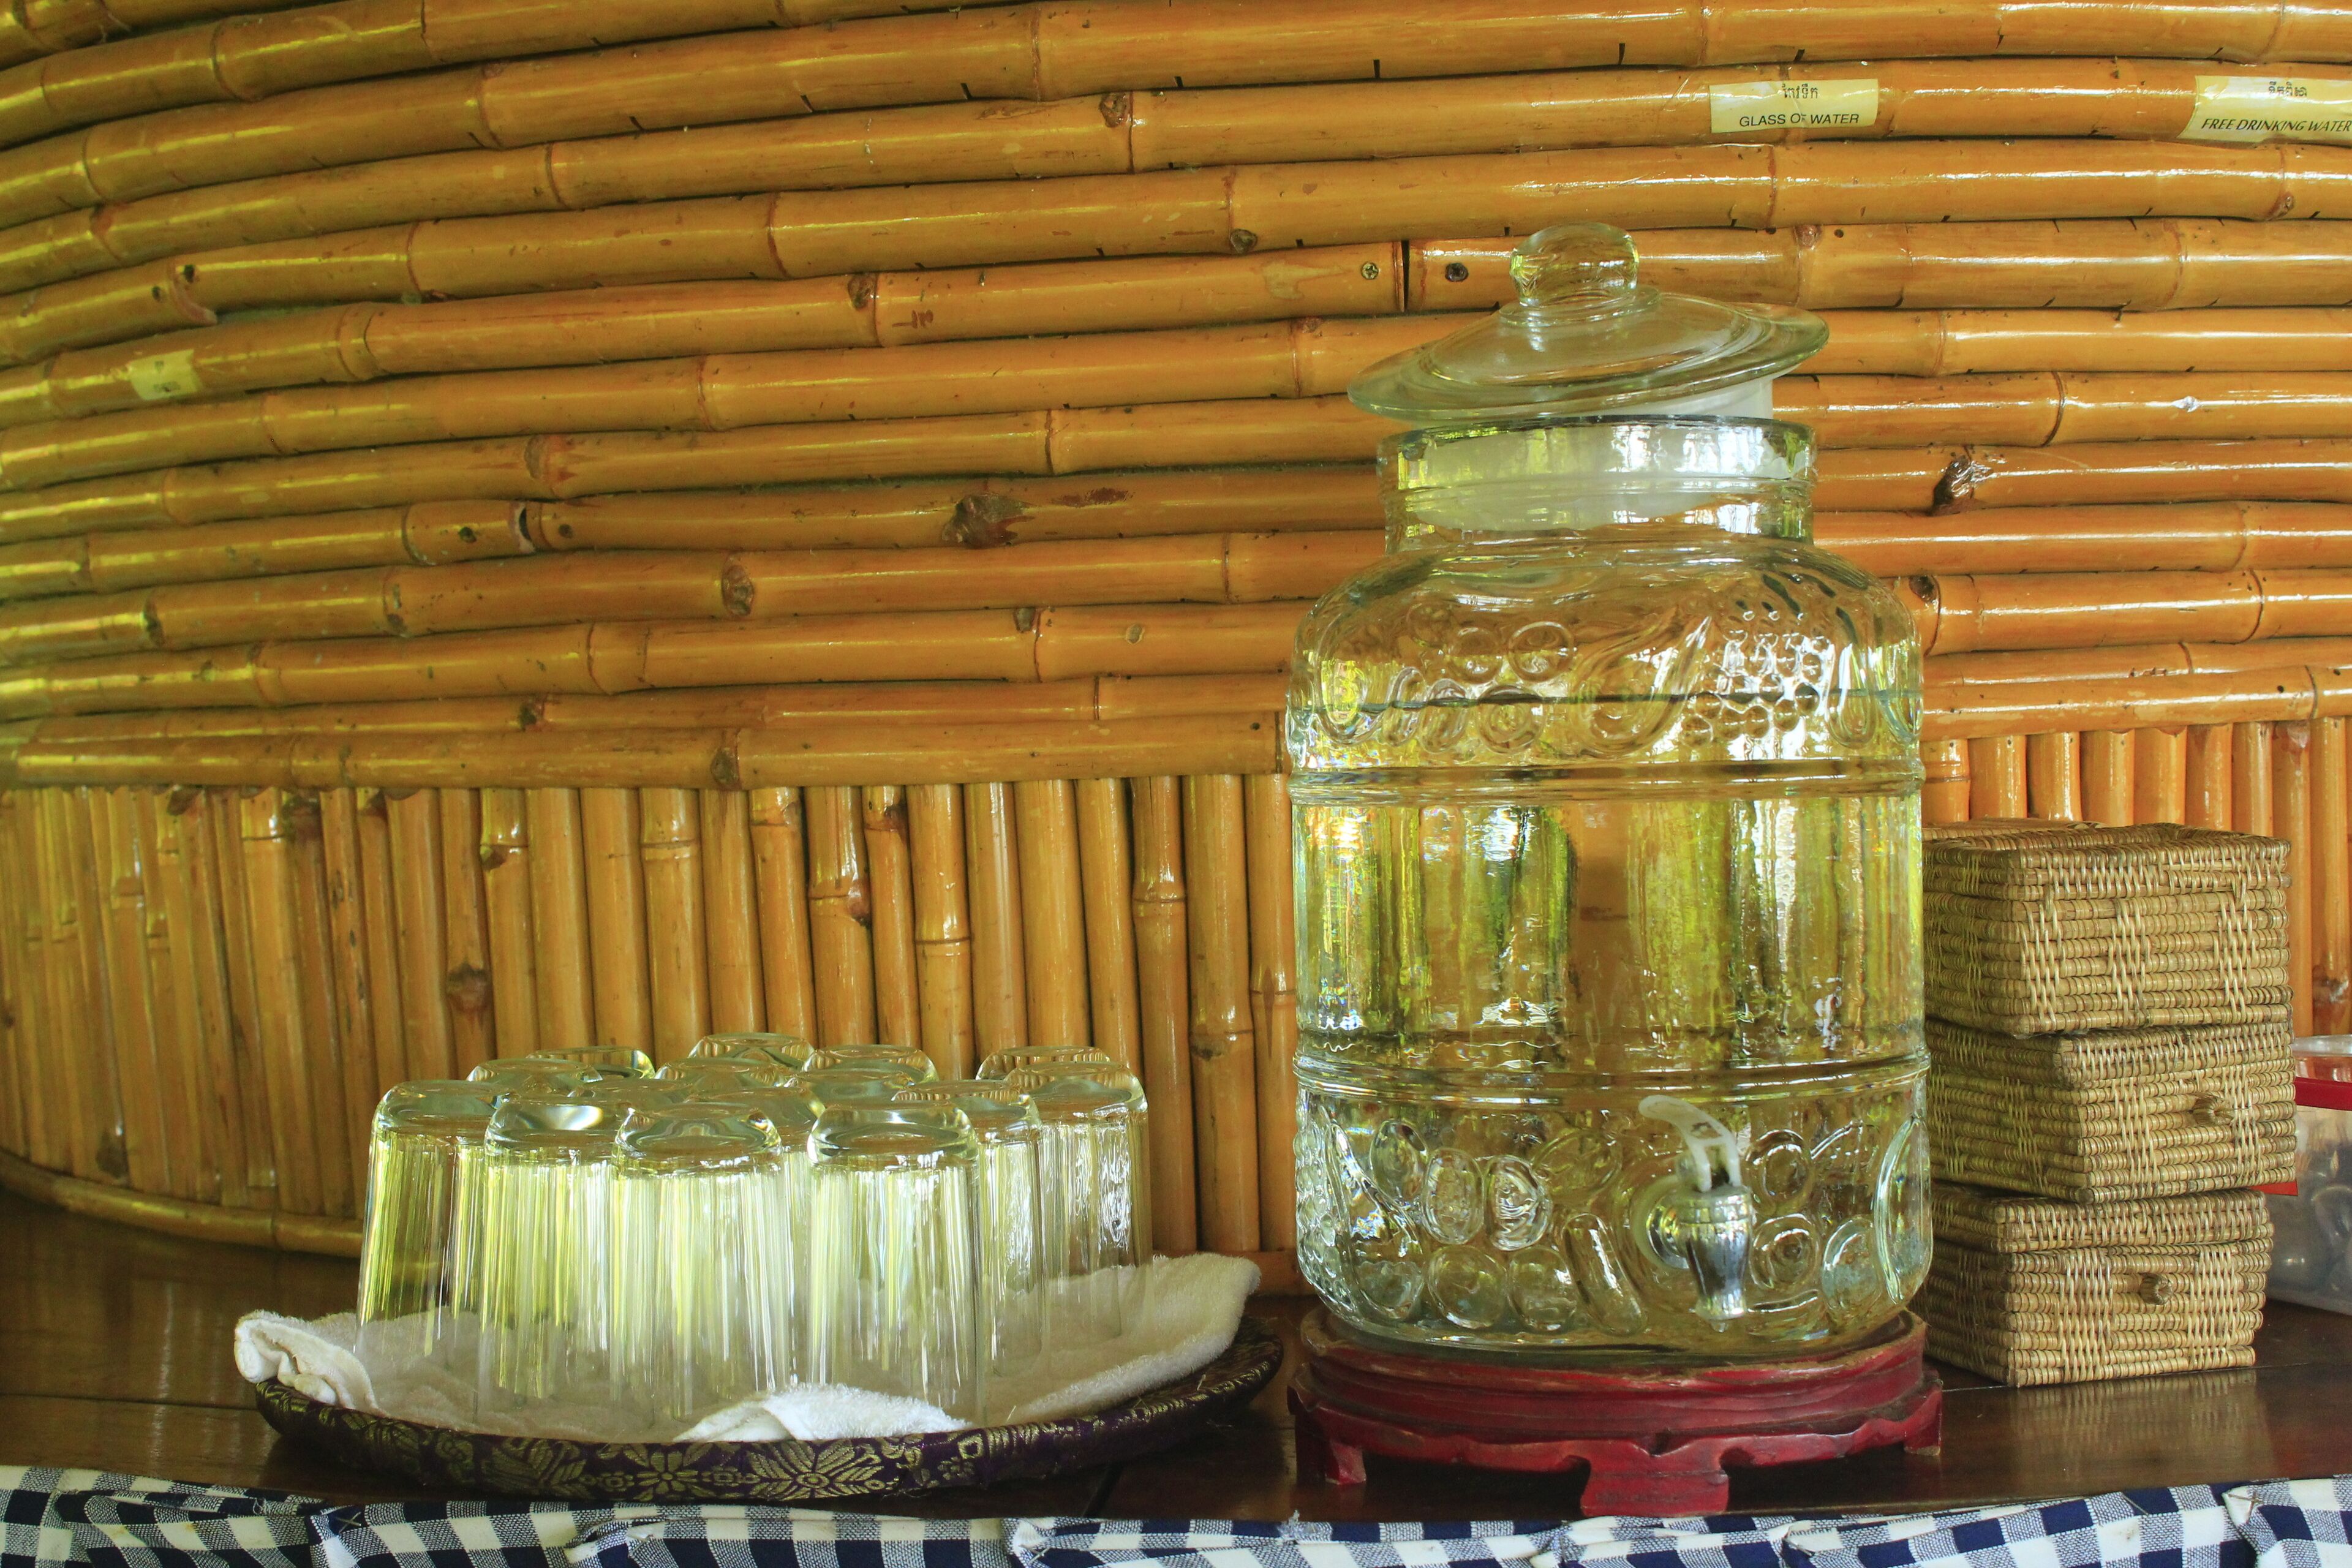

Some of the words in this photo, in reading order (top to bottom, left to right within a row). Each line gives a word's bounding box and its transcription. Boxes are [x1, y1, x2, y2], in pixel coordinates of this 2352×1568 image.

[1740, 114, 1785, 127] GLASS
[1811, 113, 1859, 124] WATER
[2201, 118, 2236, 130] FREE
[2236, 119, 2308, 131] DRINKING
[2307, 120, 2352, 132] WATER
